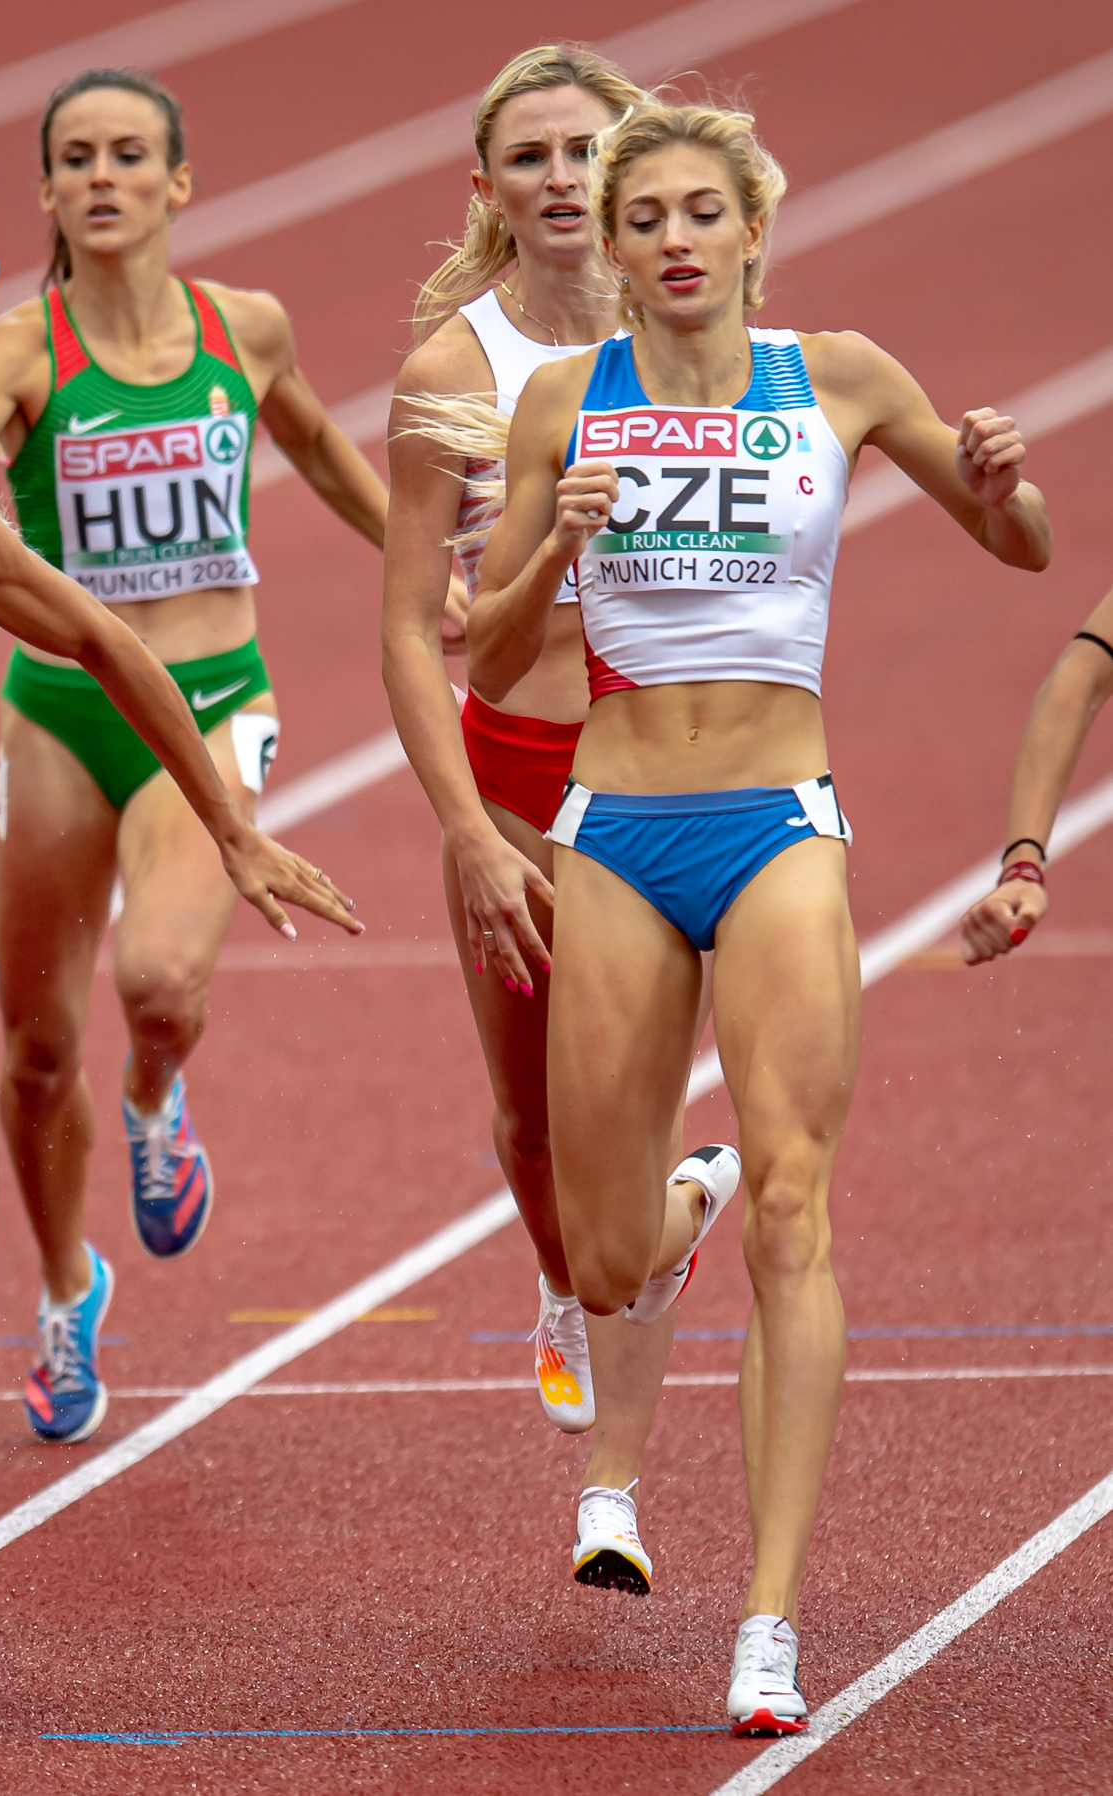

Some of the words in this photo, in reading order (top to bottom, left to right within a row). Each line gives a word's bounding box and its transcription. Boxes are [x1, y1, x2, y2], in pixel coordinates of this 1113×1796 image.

[63, 431, 200, 476] SPAR
[585, 416, 734, 452] SPAR
[73, 474, 235, 551] HUN
[606, 466, 770, 534] CZE
[622, 534, 628, 550] I
[632, 533, 672, 550] RUN
[78, 567, 183, 596] MUNICH
[192, 557, 252, 584] 2022
[599, 557, 697, 584] MUNICH
[708, 558, 778, 585] 2022
